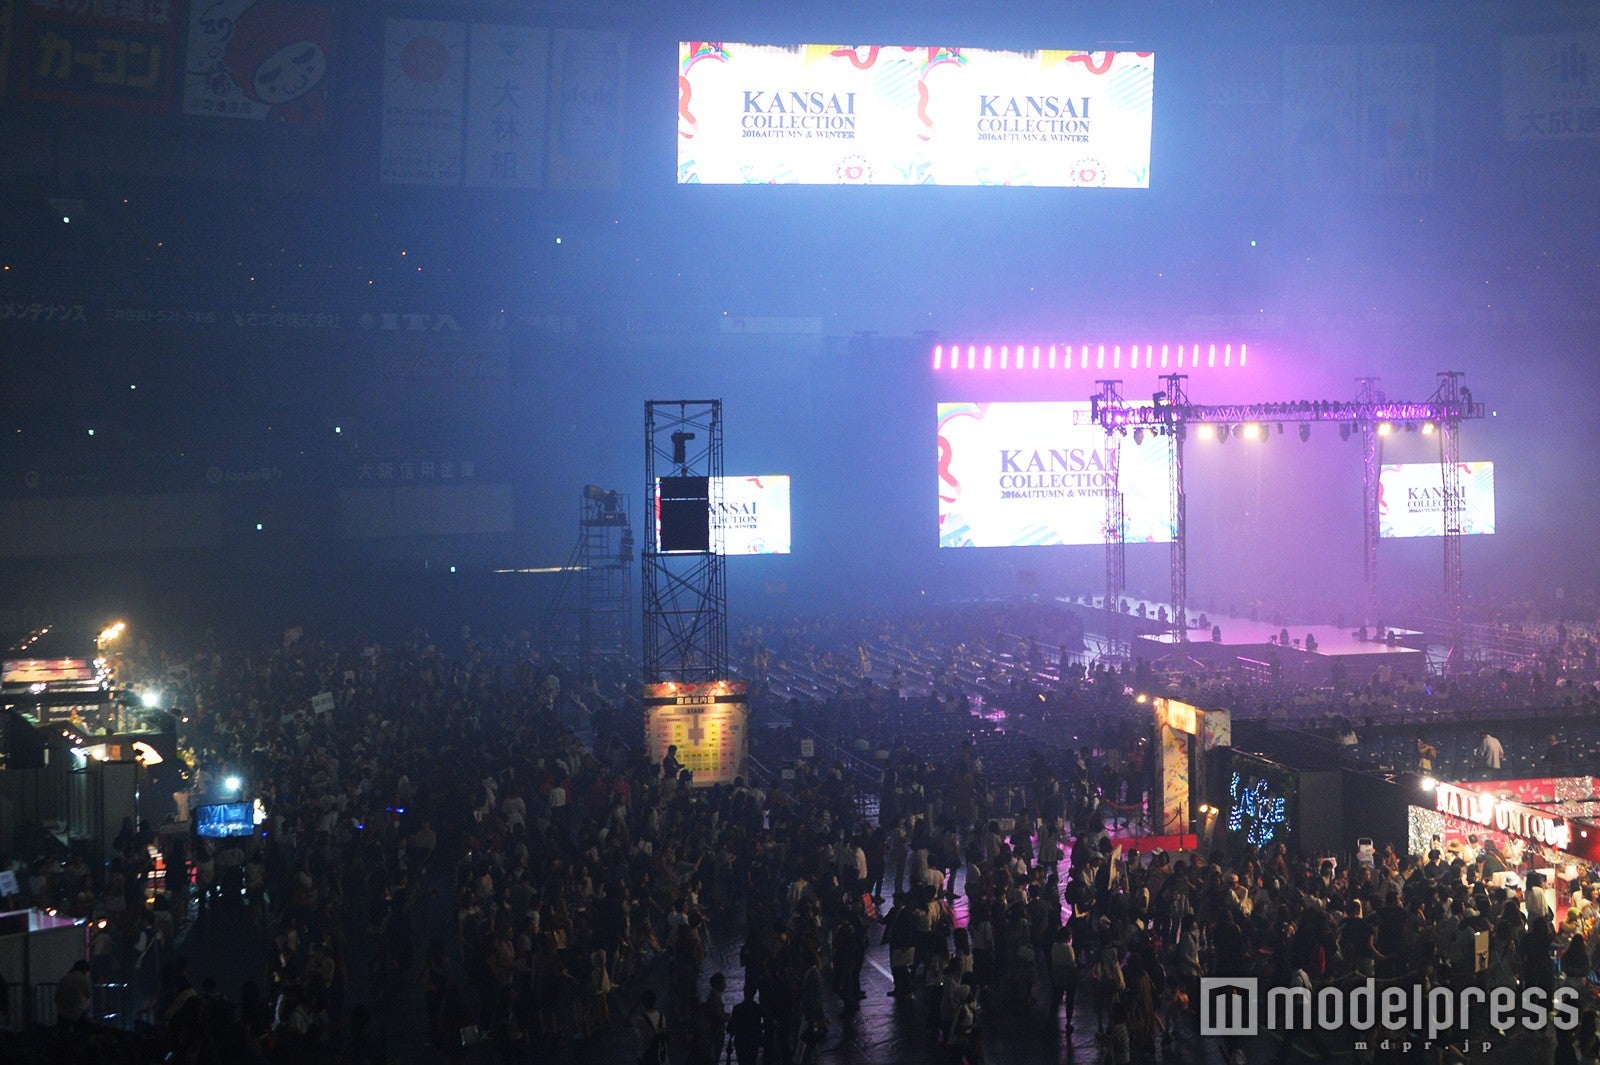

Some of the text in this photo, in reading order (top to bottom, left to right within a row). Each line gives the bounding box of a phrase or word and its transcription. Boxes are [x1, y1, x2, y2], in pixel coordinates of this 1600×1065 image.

[742, 91, 856, 115] KANSAI
[979, 95, 1091, 119] KANSAI
[489, 80, 521, 179] 大林組
[741, 115, 855, 130] COLLECTION
[977, 118, 1090, 133] COLLECTION
[816, 130, 855, 139] WINTER
[1050, 134, 1089, 143] WINTER
